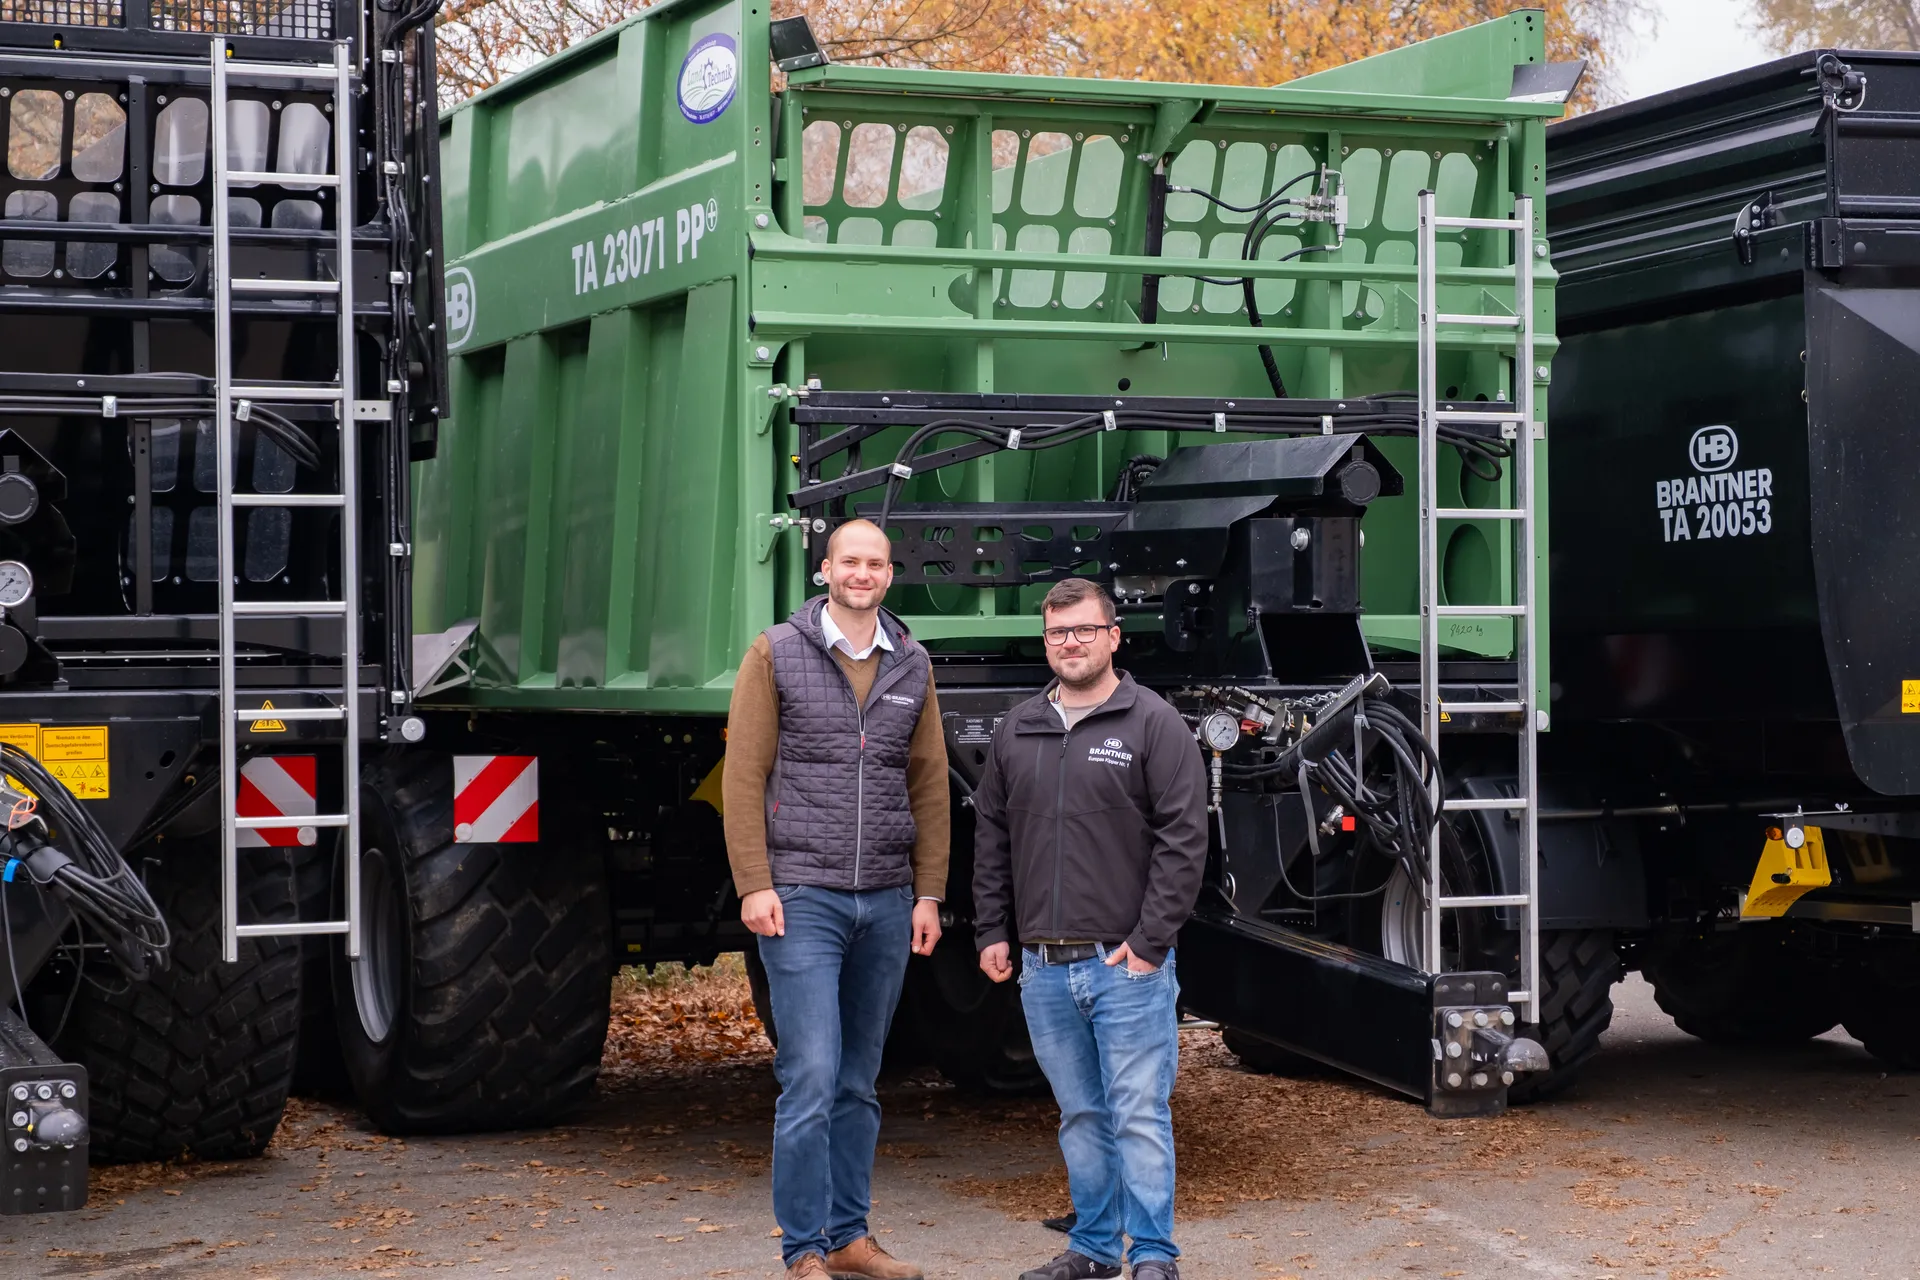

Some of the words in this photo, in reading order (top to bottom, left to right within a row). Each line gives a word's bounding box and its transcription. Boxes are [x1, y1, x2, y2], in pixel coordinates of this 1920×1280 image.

[572, 240, 598, 295] TA
[603, 216, 665, 287] 23071
[1697, 433, 1731, 463] HB
[1656, 468, 1773, 508] BRANTNER
[1660, 507, 1691, 542] TA
[1696, 498, 1772, 539] 20053
[1089, 748, 1132, 761] BRANTNER
[1105, 757, 1119, 765] Kipper
